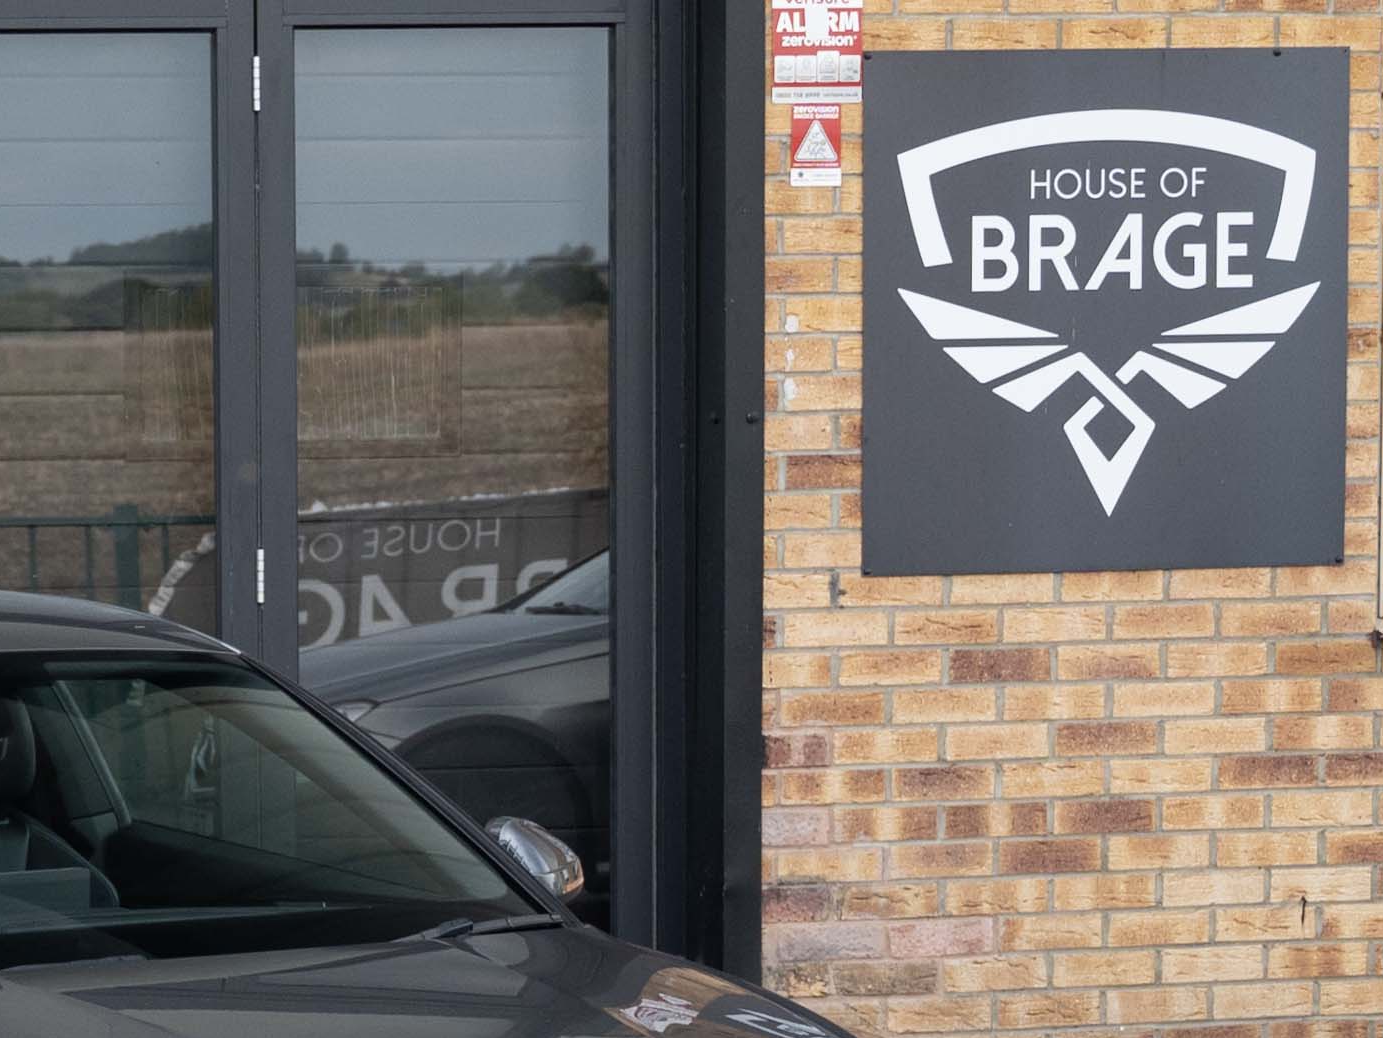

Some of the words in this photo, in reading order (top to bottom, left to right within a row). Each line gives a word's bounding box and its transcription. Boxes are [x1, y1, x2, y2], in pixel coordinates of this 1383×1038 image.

[775, 11, 860, 33] ALRM
[1029, 168, 1147, 200] HOUSE
[1158, 167, 1208, 199] OF
[970, 211, 1255, 293] BRAGE
